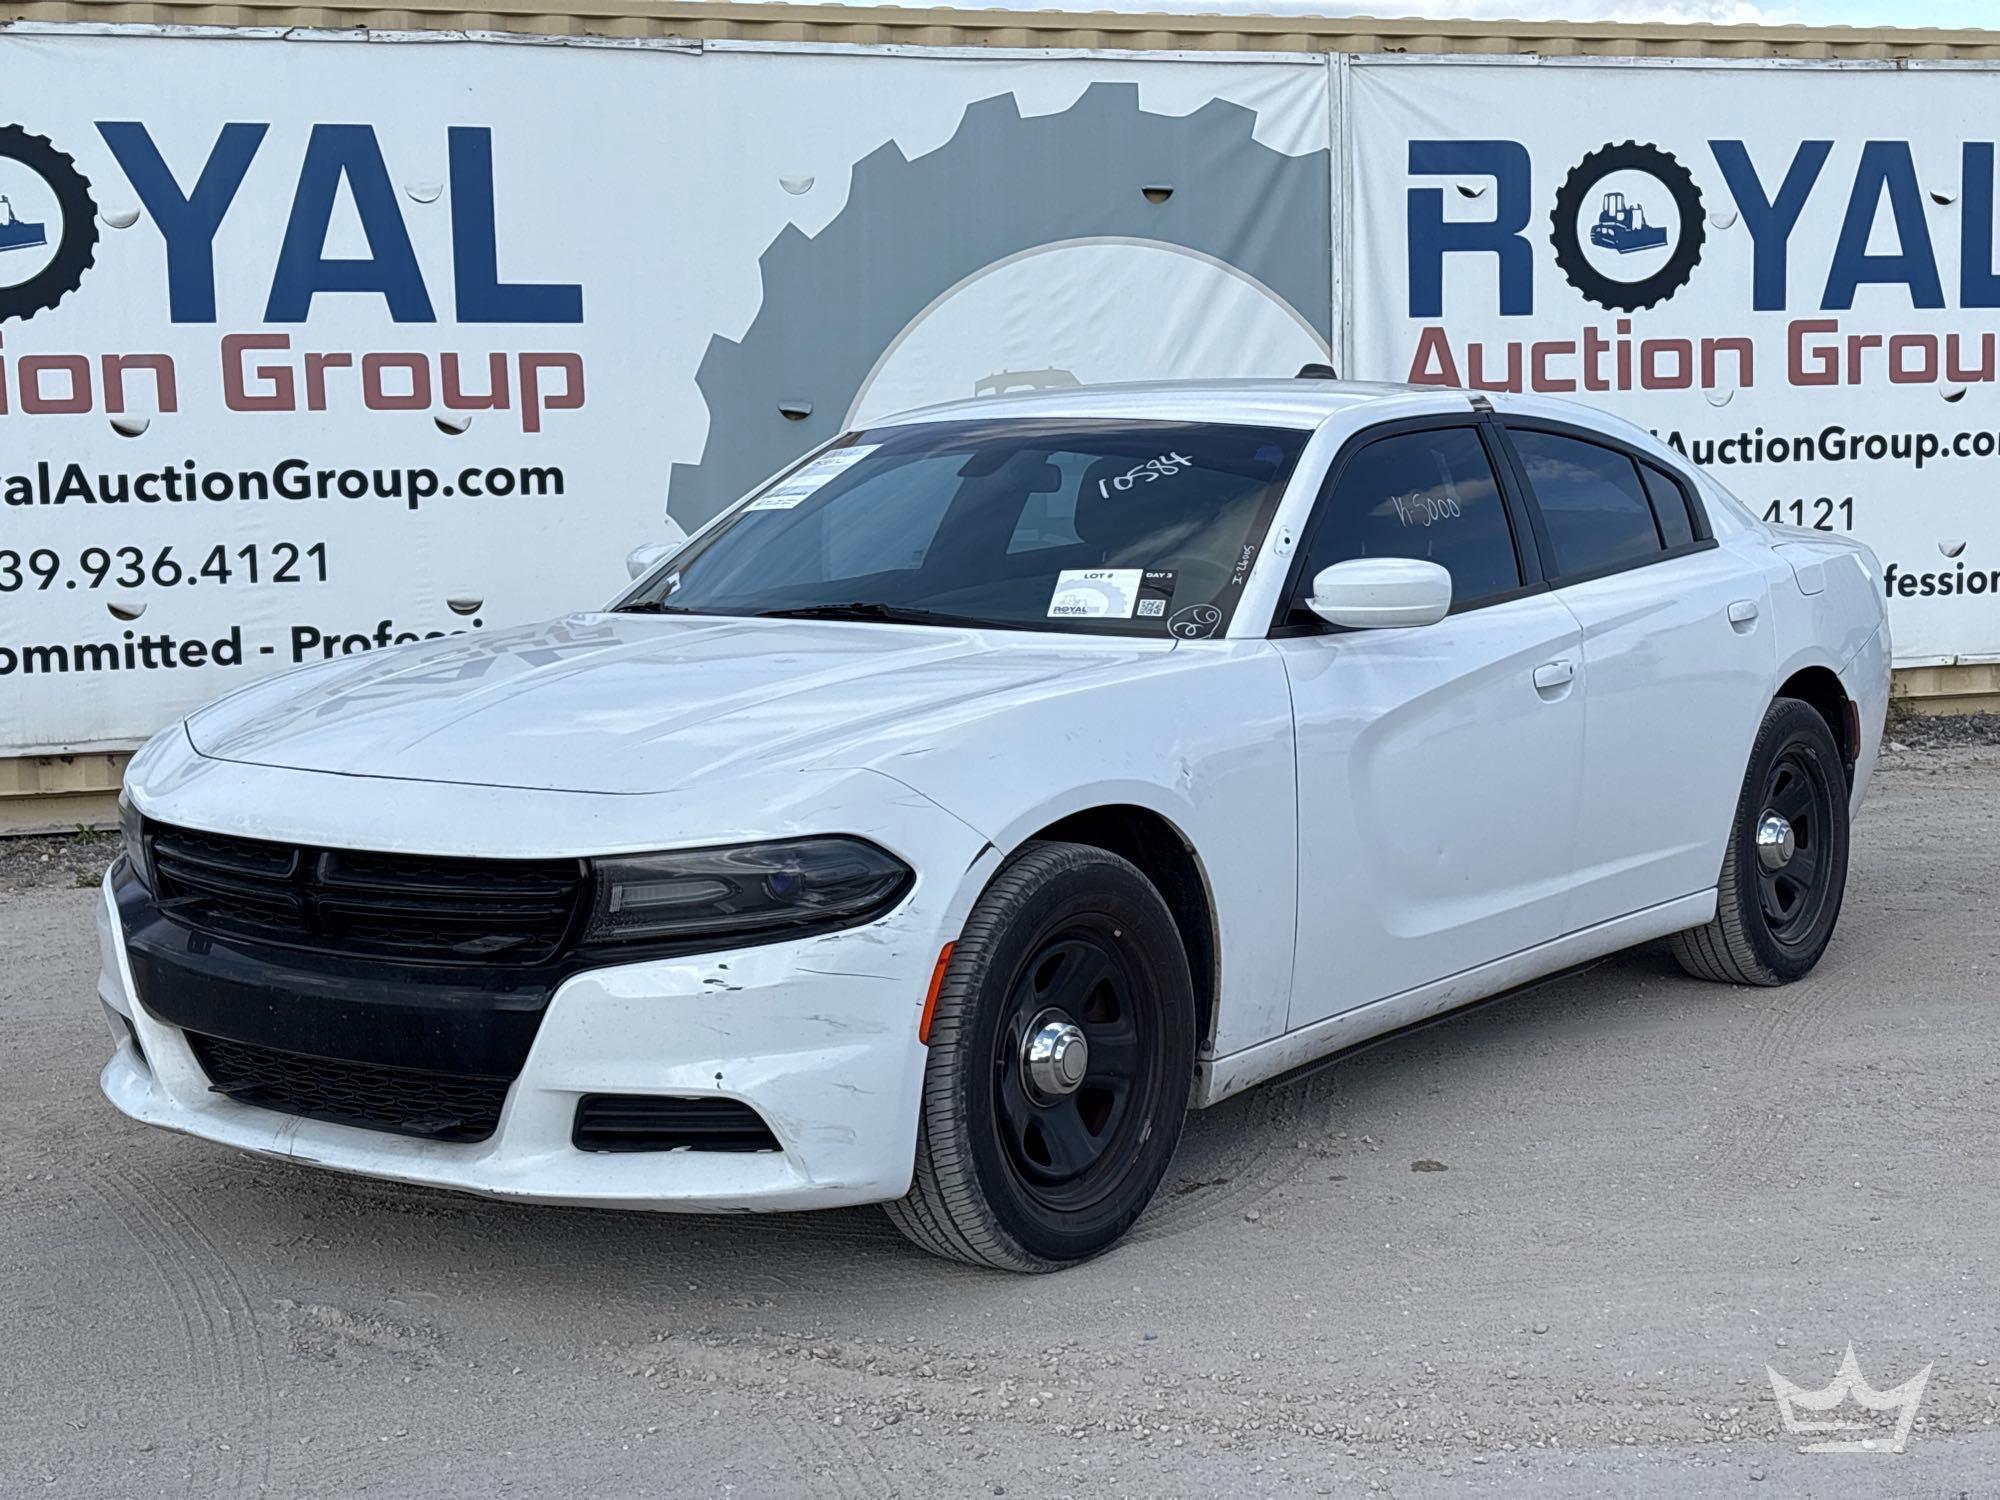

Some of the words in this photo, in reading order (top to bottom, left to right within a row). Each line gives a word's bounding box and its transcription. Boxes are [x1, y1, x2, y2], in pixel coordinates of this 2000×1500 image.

[1407, 319, 1754, 393] Auction
[221, 333, 586, 433] Group
[1649, 426, 2000, 469] AuctionGroup.co
[0, 458, 564, 509] alAuctionGroup.com
[1098, 451, 1193, 499] 10584
[0, 542, 328, 592] 39.936.4121
